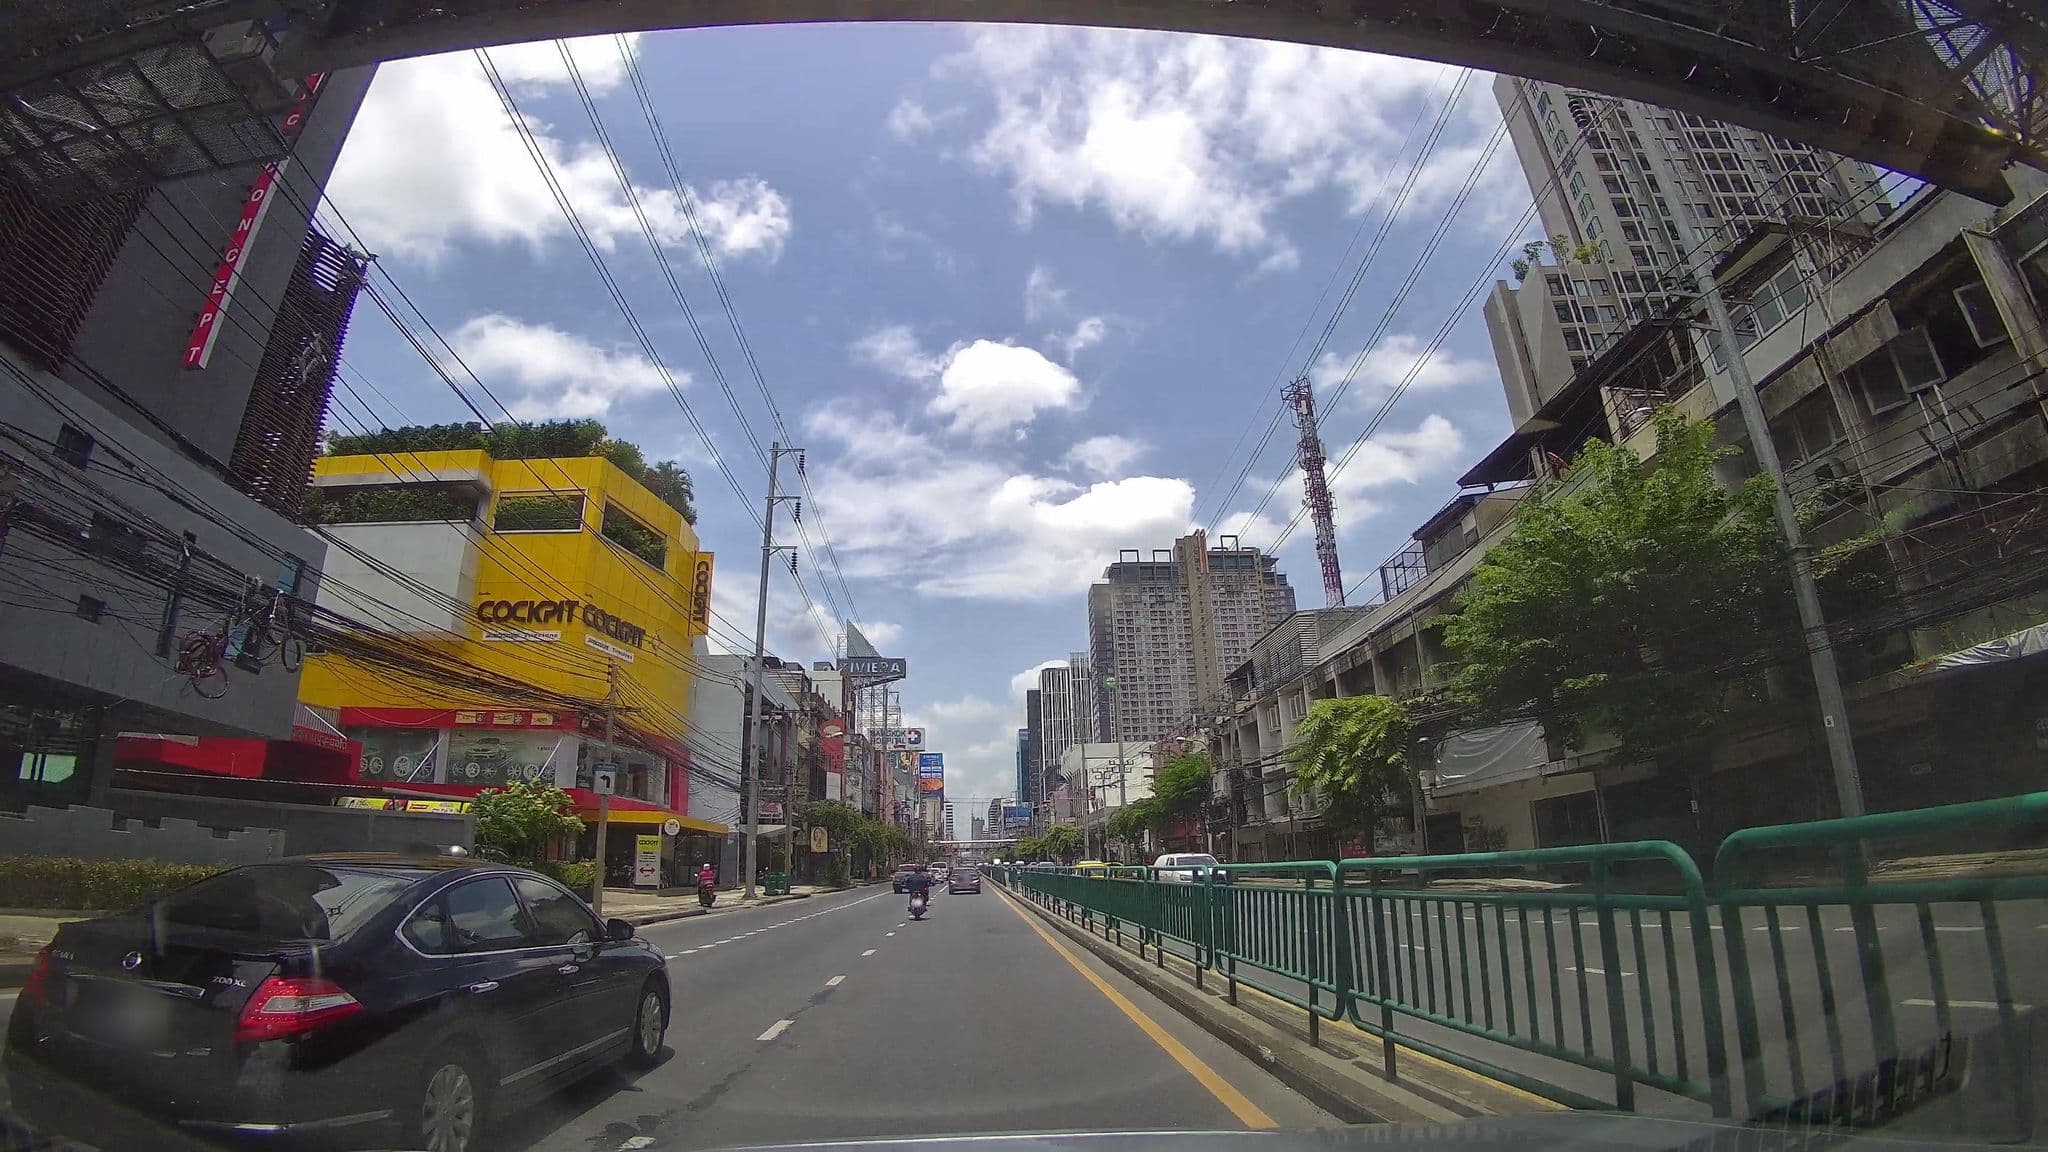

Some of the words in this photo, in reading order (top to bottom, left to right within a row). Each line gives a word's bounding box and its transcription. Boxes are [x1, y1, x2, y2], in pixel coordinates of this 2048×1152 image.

[477, 600, 579, 624] COCKPIT
[693, 561, 709, 622] COCKPIT
[583, 604, 646, 649] COCKPIT
